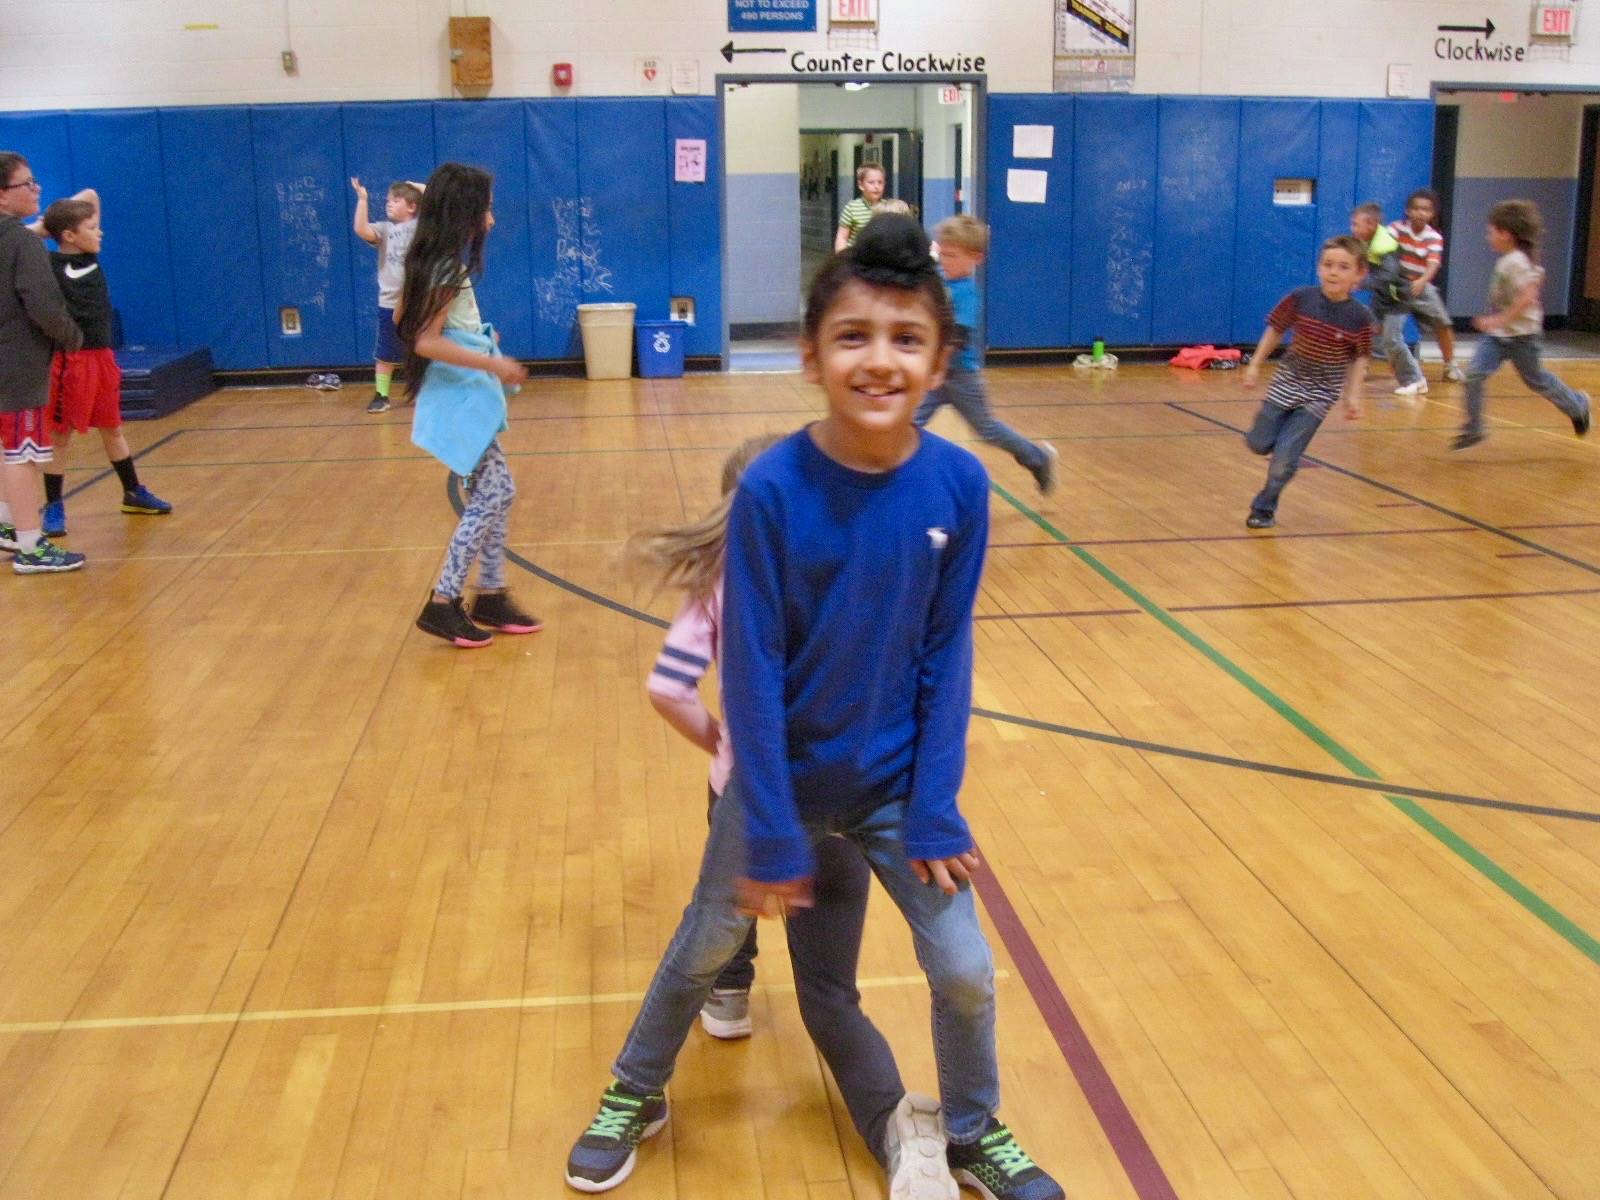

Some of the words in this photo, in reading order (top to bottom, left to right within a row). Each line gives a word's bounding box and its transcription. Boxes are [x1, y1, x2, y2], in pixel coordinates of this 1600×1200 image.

[735, 0, 754, 9] NOT
[758, 0, 771, 9] TO
[772, 0, 809, 9] EXCEED
[838, 0, 870, 17] EXIT
[760, 11, 804, 21] PERSONS
[1543, 8, 1570, 32] EXIT
[1434, 38, 1525, 62] Clockwise
[791, 51, 875, 73] Counter
[882, 51, 986, 73] Clockwise
